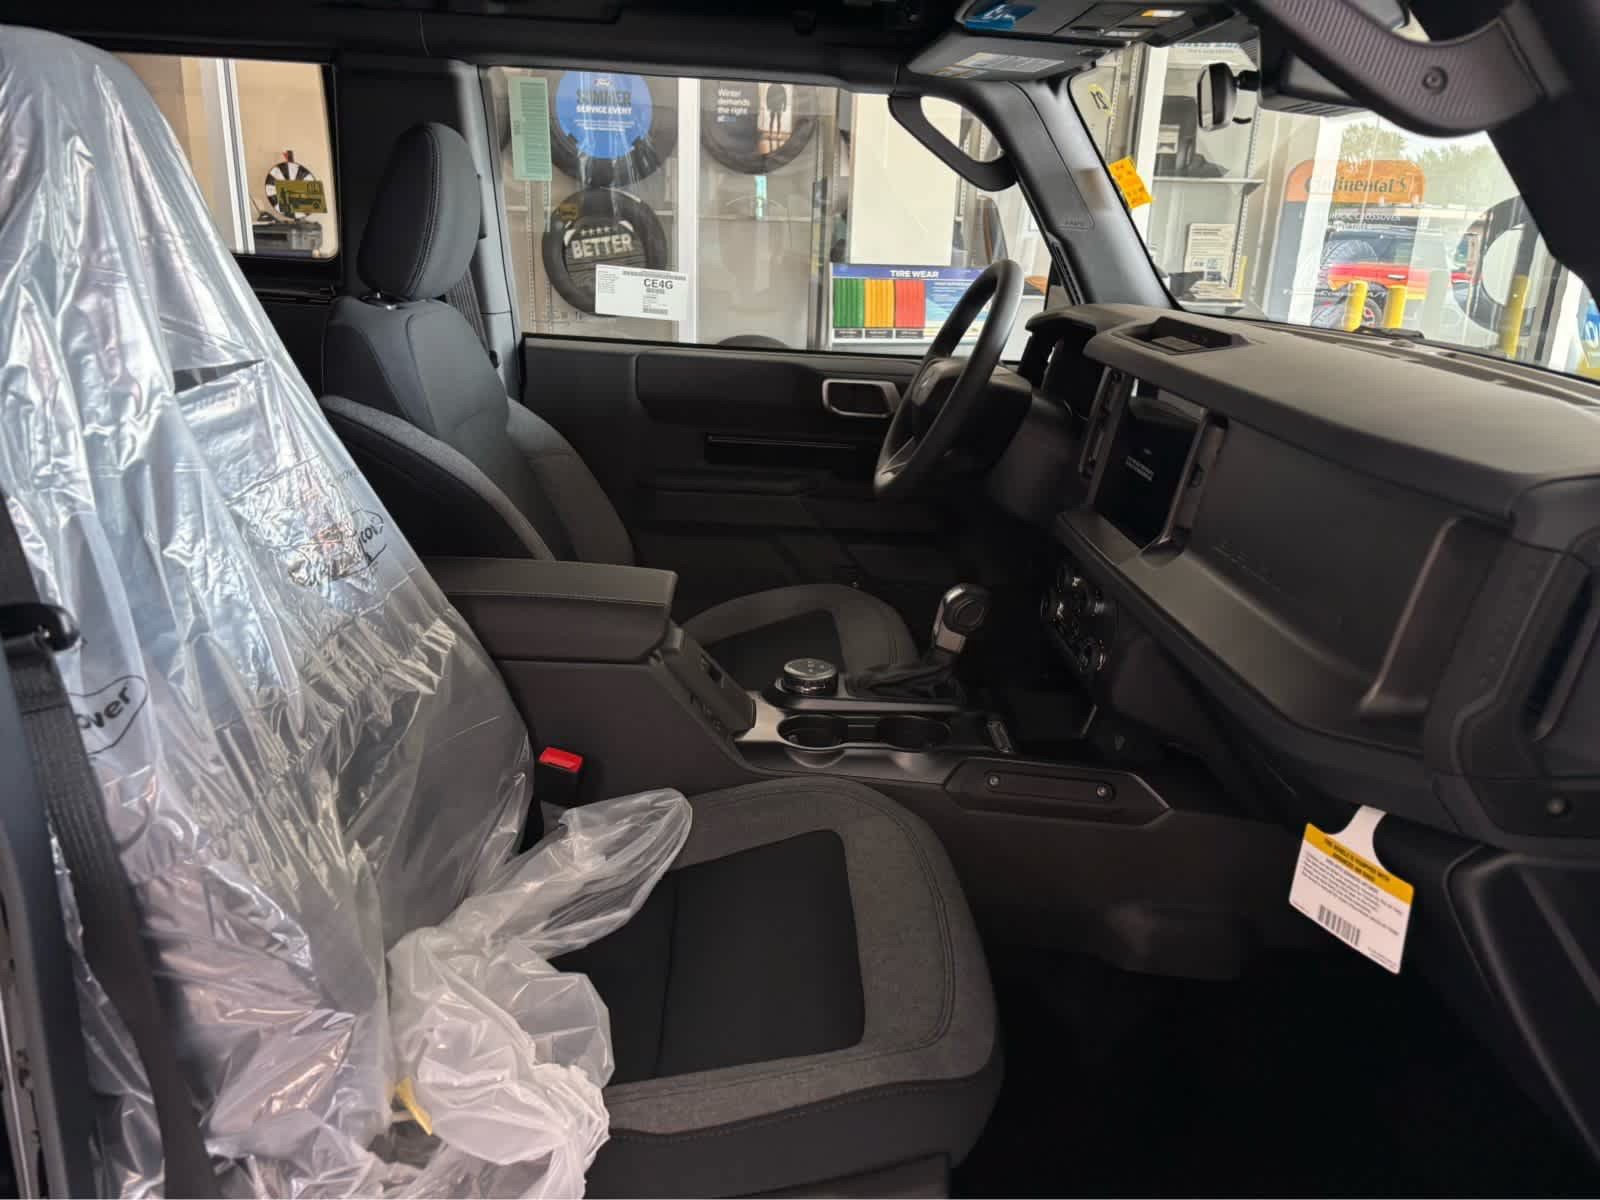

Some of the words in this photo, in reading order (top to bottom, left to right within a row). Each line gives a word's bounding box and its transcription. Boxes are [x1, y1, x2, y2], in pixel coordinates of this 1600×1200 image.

[1305, 176, 1394, 193] tinental
[571, 233, 633, 260] BETTER
[889, 269, 911, 279] TIRE
[912, 270, 940, 279] WEAR
[643, 278, 674, 290] CE4G
